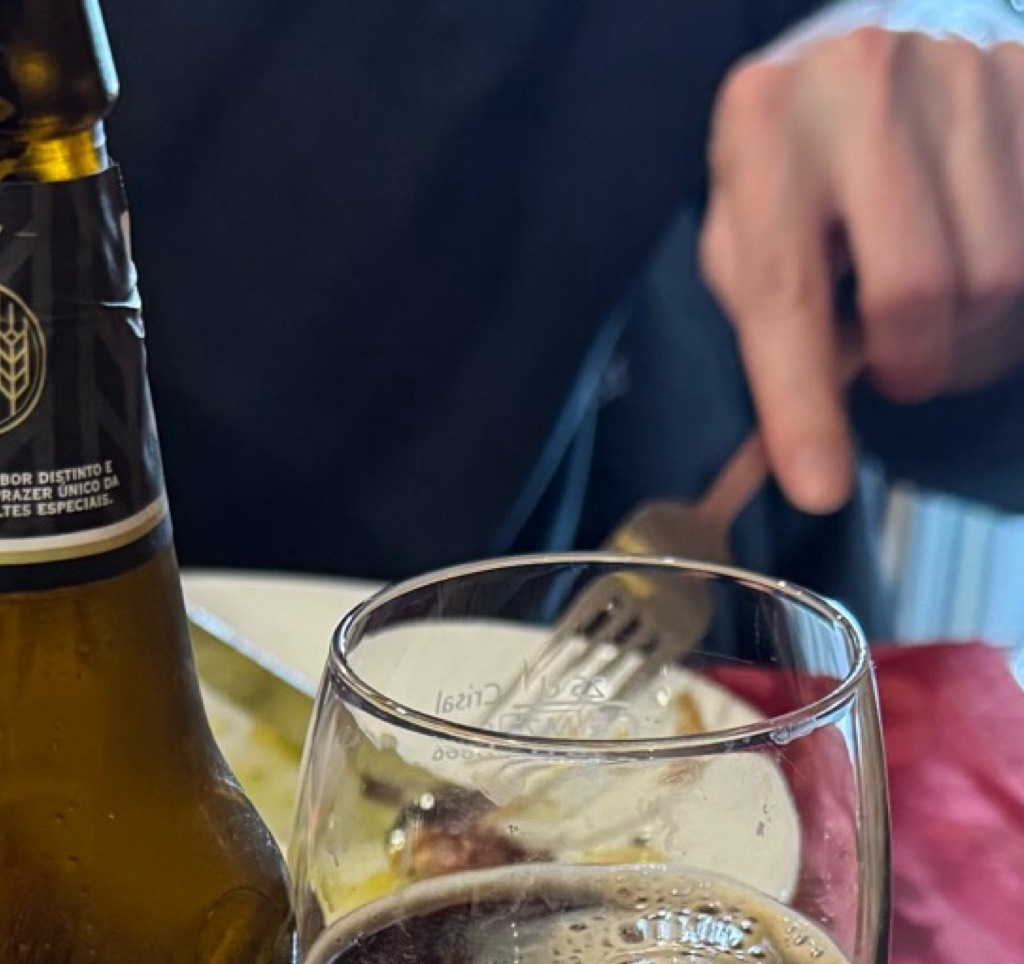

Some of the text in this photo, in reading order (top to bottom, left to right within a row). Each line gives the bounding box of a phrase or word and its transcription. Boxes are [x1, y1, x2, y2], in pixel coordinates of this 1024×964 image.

[38, 463, 101, 484] DISTINTO
[104, 460, 113, 474] E
[58, 478, 101, 499] ÚNICO
[103, 474, 120, 490] DA
